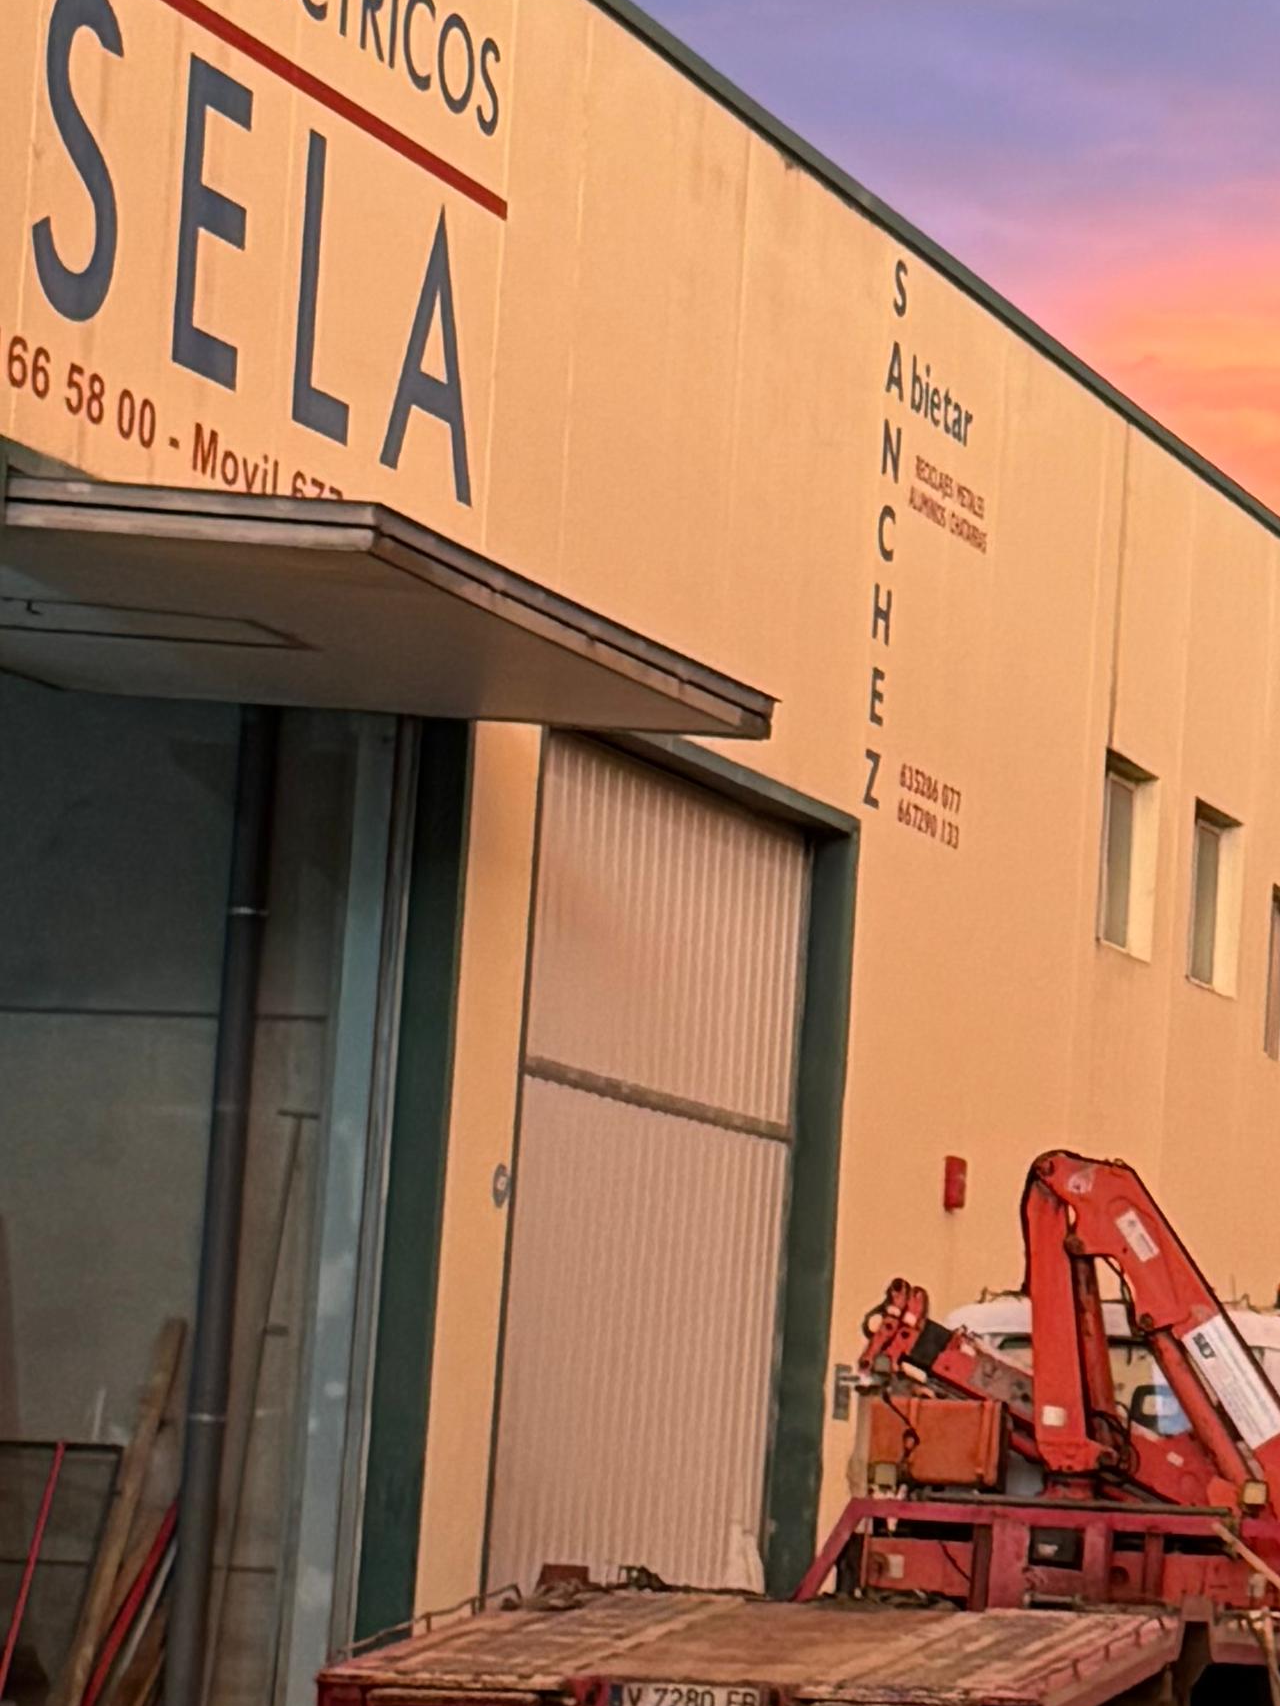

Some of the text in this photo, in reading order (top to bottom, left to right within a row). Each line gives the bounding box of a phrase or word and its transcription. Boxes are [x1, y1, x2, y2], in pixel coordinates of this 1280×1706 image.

[7, 335, 50, 400] 66
[65, 362, 105, 425] 58
[117, 389, 156, 449] 00
[192, 422, 280, 496] Movil
[862, 259, 908, 810] SANCHEZ
